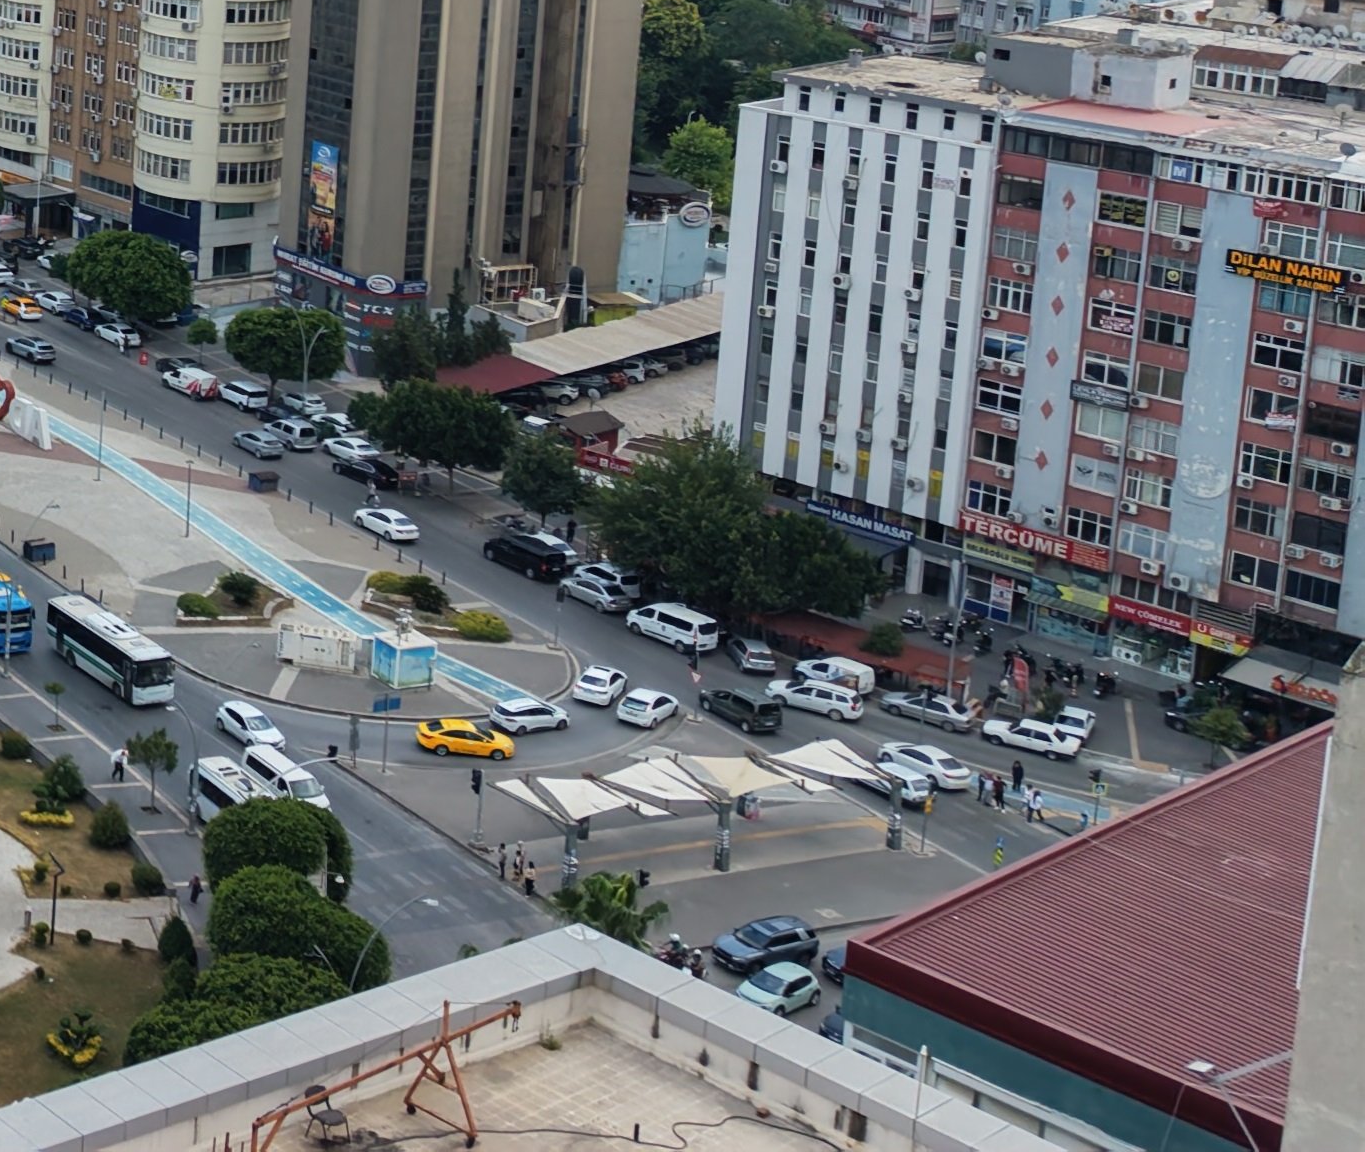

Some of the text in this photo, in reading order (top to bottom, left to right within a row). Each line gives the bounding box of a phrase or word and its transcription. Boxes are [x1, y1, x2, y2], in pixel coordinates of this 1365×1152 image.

[831, 509, 873, 530] HASAN
[873, 521, 915, 541] MASAT
[961, 515, 1069, 560] TERCÜME
[1114, 603, 1137, 615] NEW
